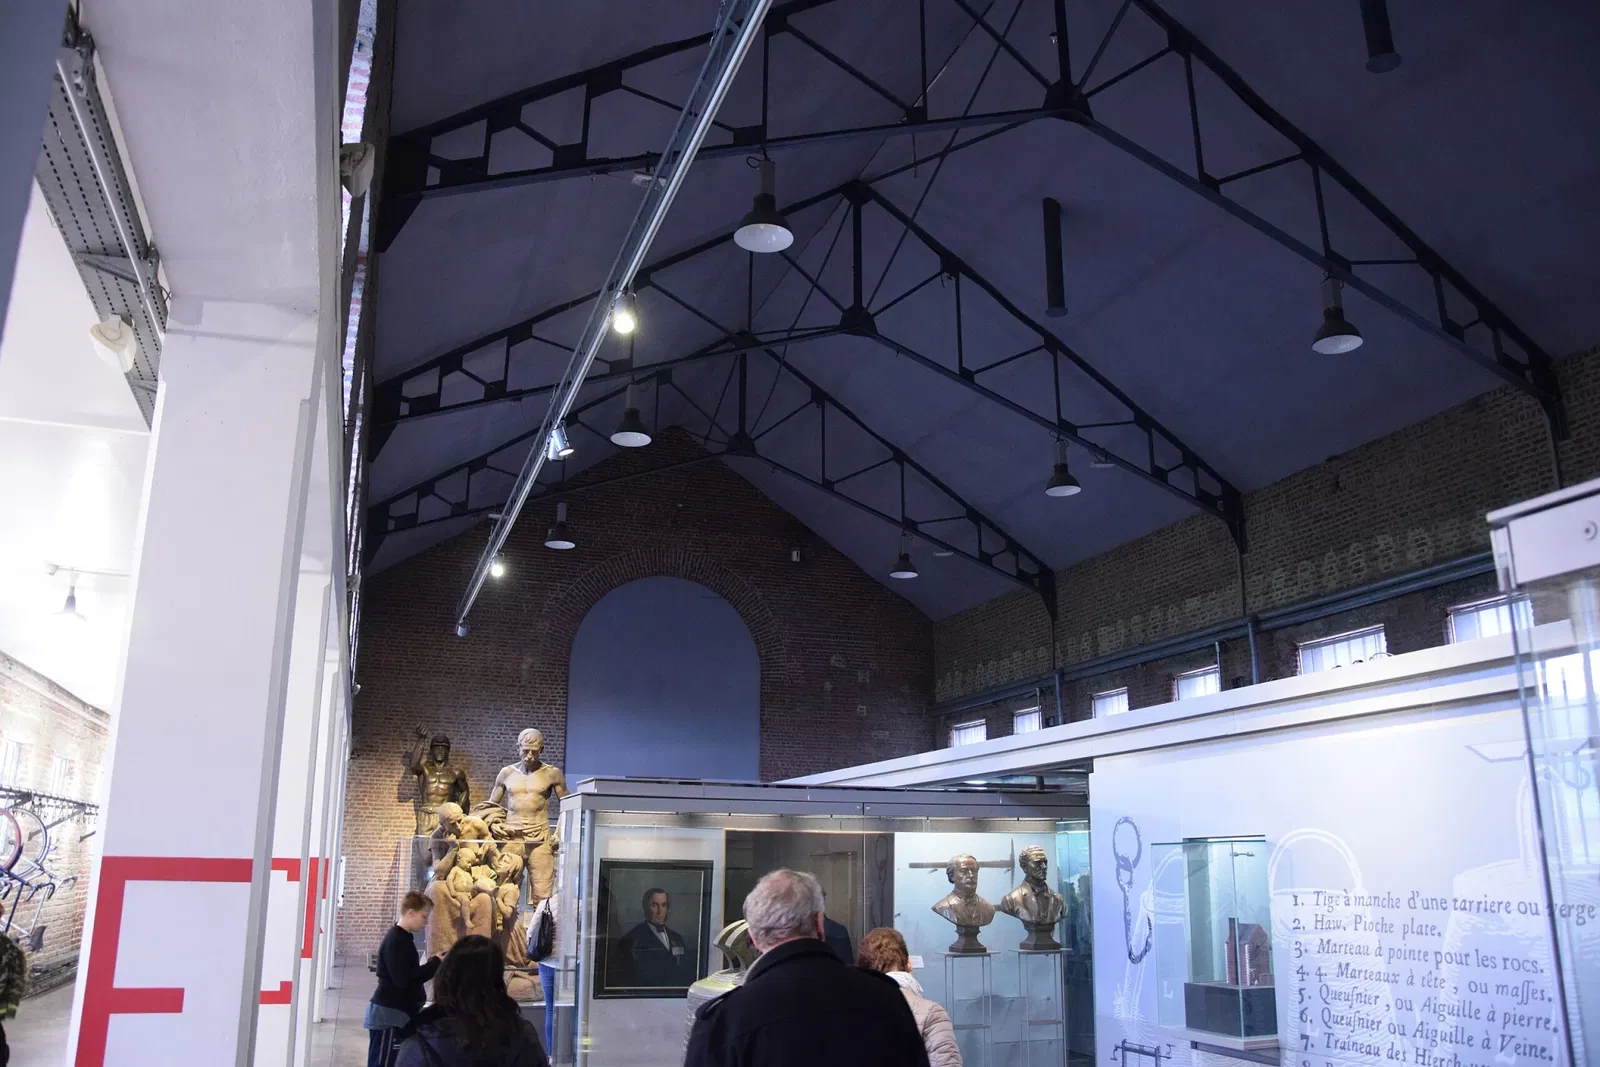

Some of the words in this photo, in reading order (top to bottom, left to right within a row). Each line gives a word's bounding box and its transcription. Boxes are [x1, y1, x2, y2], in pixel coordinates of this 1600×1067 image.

[1292, 894, 1304, 907] 1.
[1312, 890, 1340, 913] Tige
[1343, 888, 1351, 907] à
[1354, 891, 1401, 909] manche
[1407, 891, 1448, 911] d'une
[1453, 894, 1512, 914] tarriere
[1517, 901, 1540, 916] ou
[1353, 914, 1394, 934] Pioche
[1402, 917, 1442, 940] plate.
[1294, 940, 1308, 959] 3.
[1316, 938, 1370, 957] Marteau
[1375, 940, 1383, 957] à
[1388, 944, 1429, 965] pointe
[1434, 950, 1470, 970] pour
[1475, 949, 1497, 969] les
[1502, 956, 1544, 974] rocs.
[1296, 964, 1310, 982] 4.
[1315, 966, 1328, 983] 4.
[1336, 962, 1400, 984] Marteaux
[1406, 968, 1415, 986] à
[1468, 980, 1488, 995] ou
[1298, 987, 1312, 1005] 5.
[1395, 998, 1413, 1012] ou
[1420, 996, 1481, 1023] Aiguille
[1487, 1004, 1496, 1023] à
[1502, 1007, 1559, 1034] pierre.
[1300, 1006, 1313, 1025] 6.
[1387, 1022, 1406, 1037] ou
[1412, 1020, 1474, 1048] Aiguille
[1481, 1029, 1492, 1051] à
[1500, 1033, 1554, 1062] Veine.
[1300, 1033, 1315, 1052] 7.
[1324, 1032, 1381, 1057] Traîneau
[1386, 1041, 1406, 1062] des
